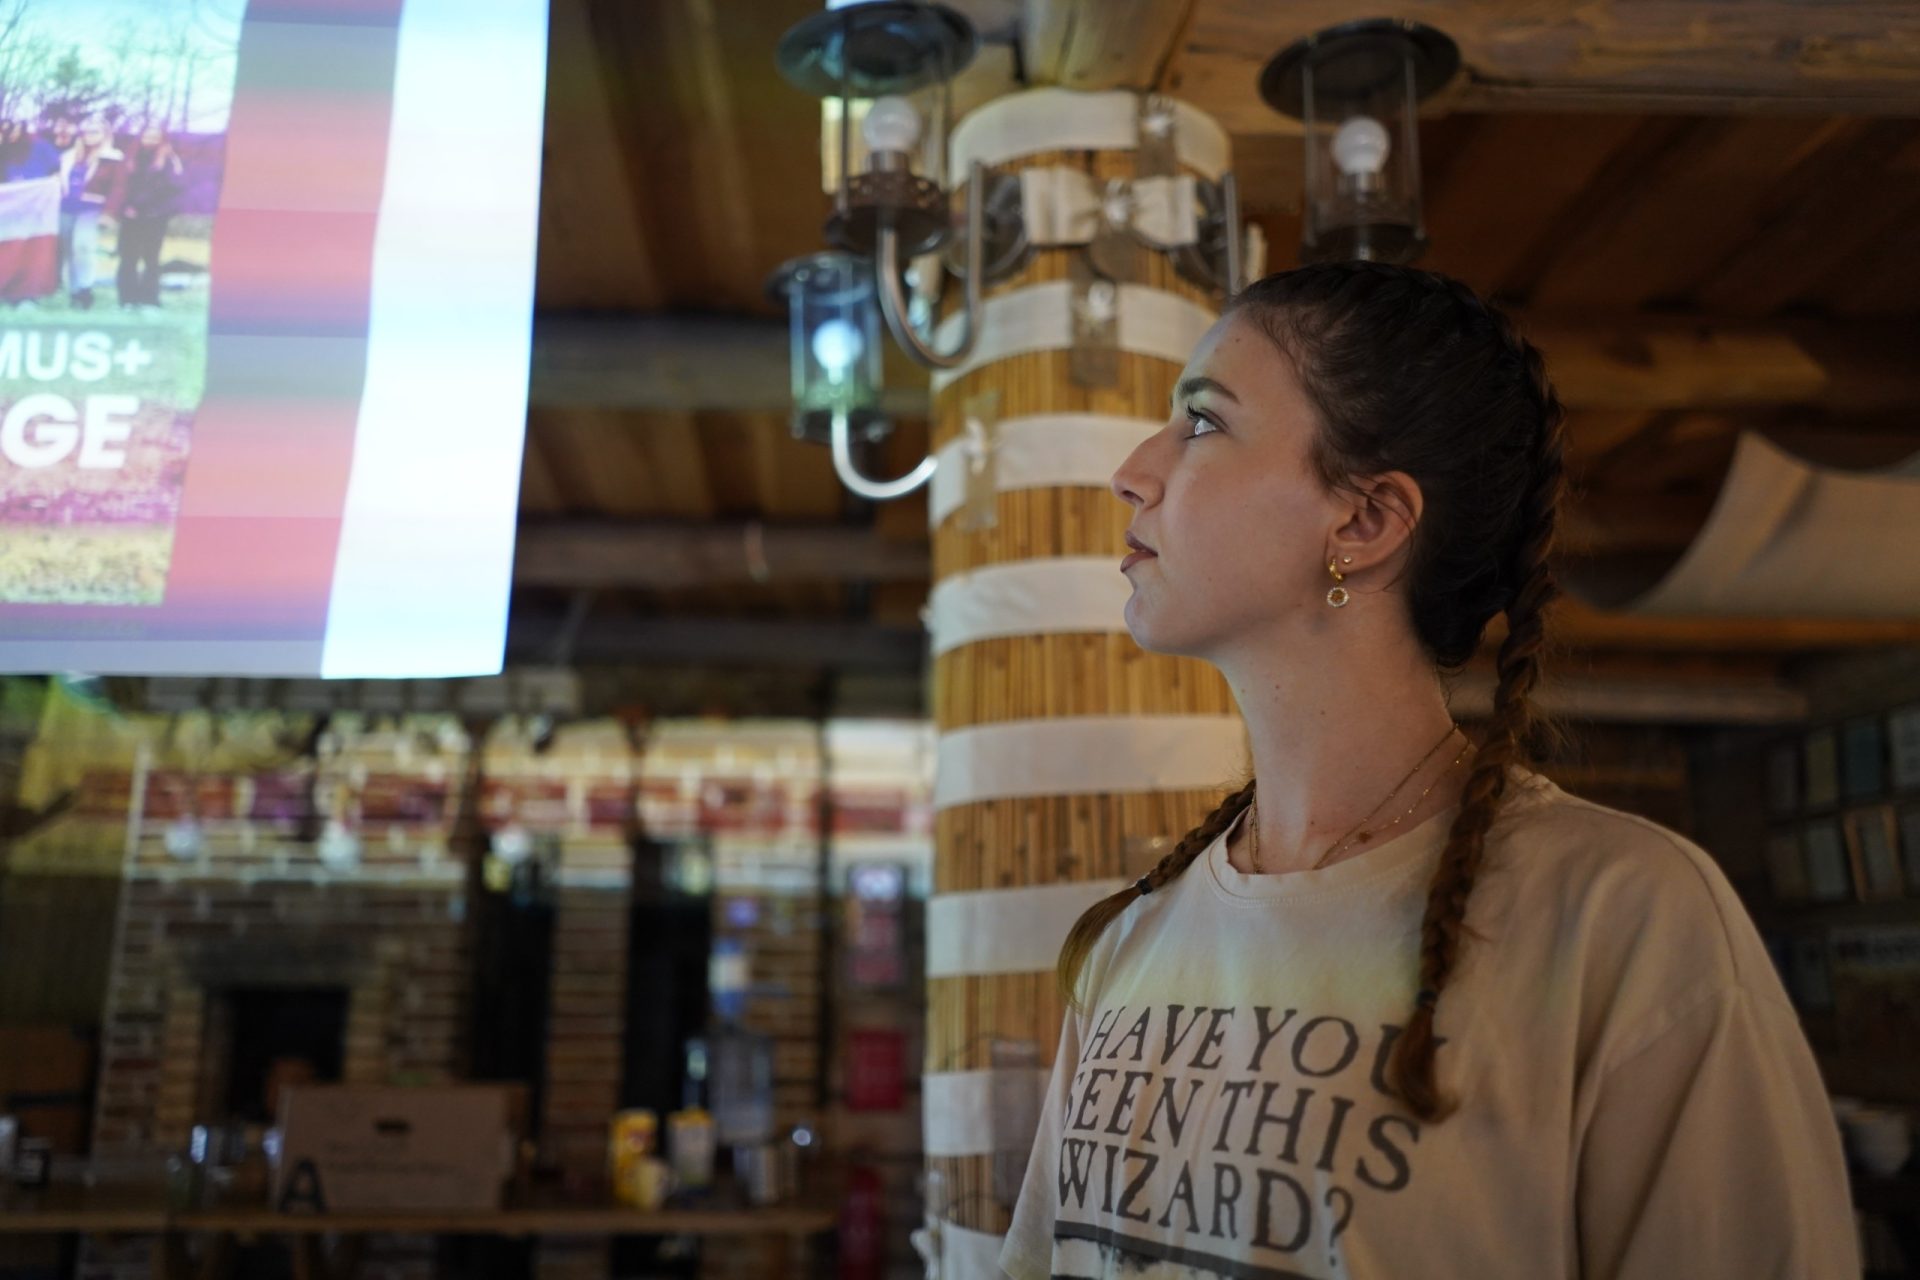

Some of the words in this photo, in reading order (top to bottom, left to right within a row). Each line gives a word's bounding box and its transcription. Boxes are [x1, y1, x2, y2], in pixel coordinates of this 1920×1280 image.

[1, 393, 140, 469] GE
[1081, 1003, 1236, 1072] HAVE
[1246, 1006, 1448, 1098] YOU
[1212, 1079, 1421, 1193] THIS
[1058, 1137, 1355, 1268] WIZARD?
